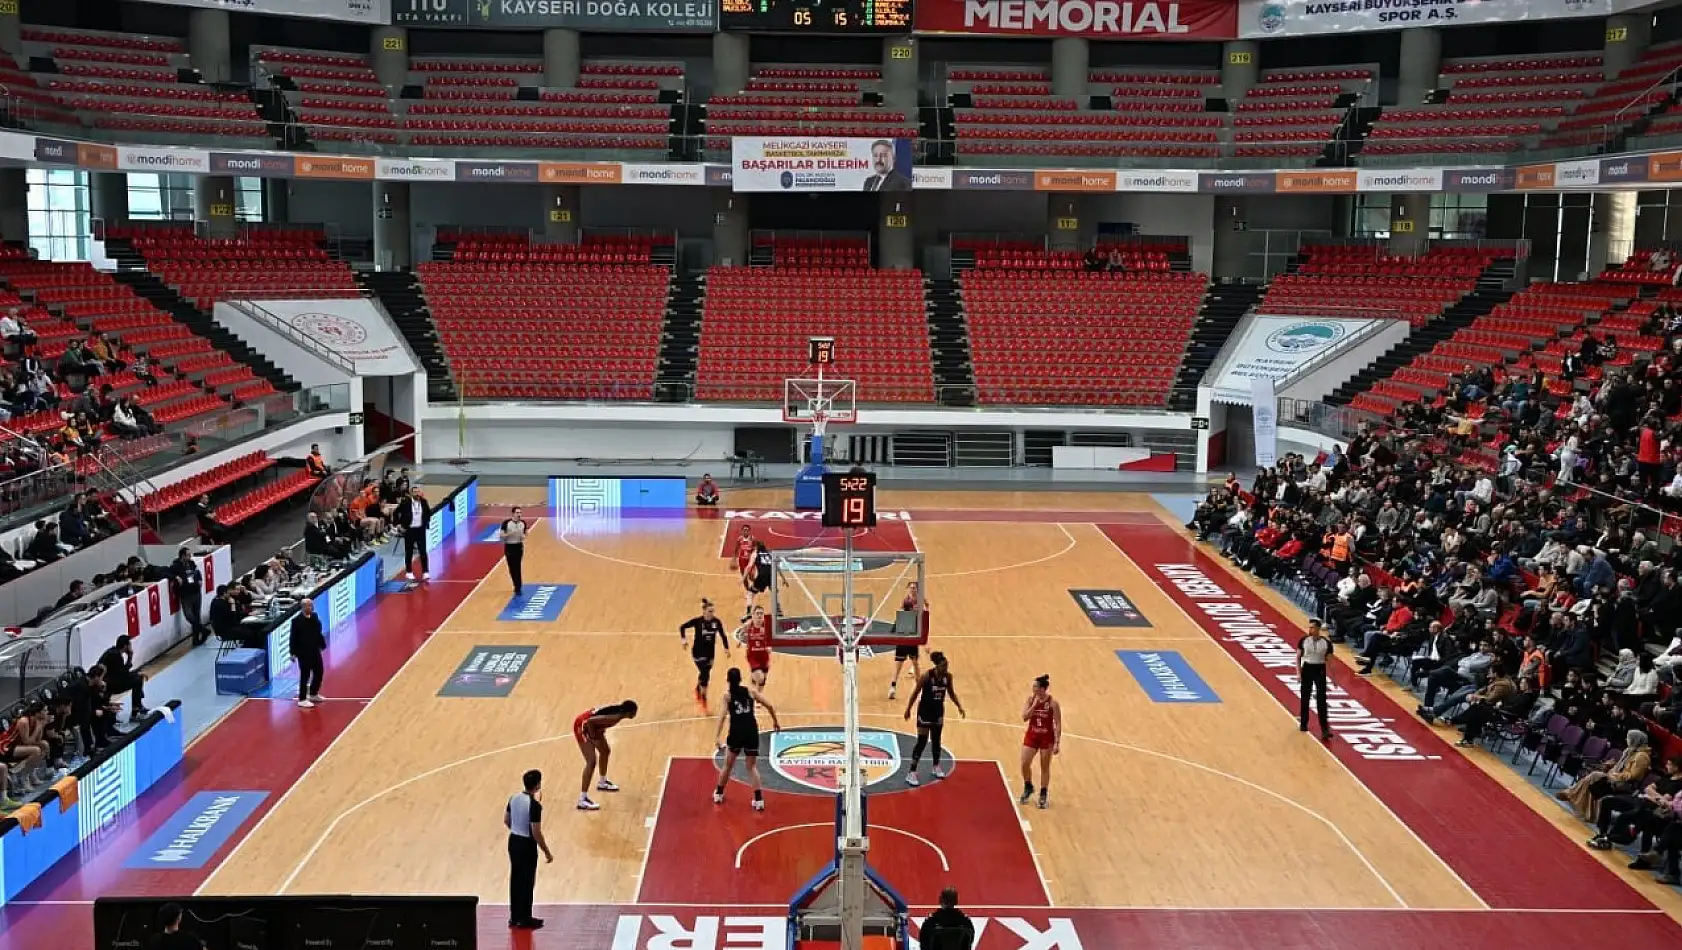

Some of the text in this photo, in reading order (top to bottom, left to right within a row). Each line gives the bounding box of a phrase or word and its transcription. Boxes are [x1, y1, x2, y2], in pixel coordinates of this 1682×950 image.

[586, 0, 641, 16] DOĞA
[396, 12, 419, 21] ETA
[793, 11, 811, 25] 05
[834, 12, 848, 25] 15
[964, 0, 1190, 33] MEMORIAL
[1378, 10, 1421, 22] SPOR
[742, 158, 869, 171] BAŞARILAR DİLERİM
[818, 350, 828, 363] 19
[840, 478, 868, 491] 5:22
[842, 498, 865, 523] 19
[174, 795, 241, 852] HALKBANK
